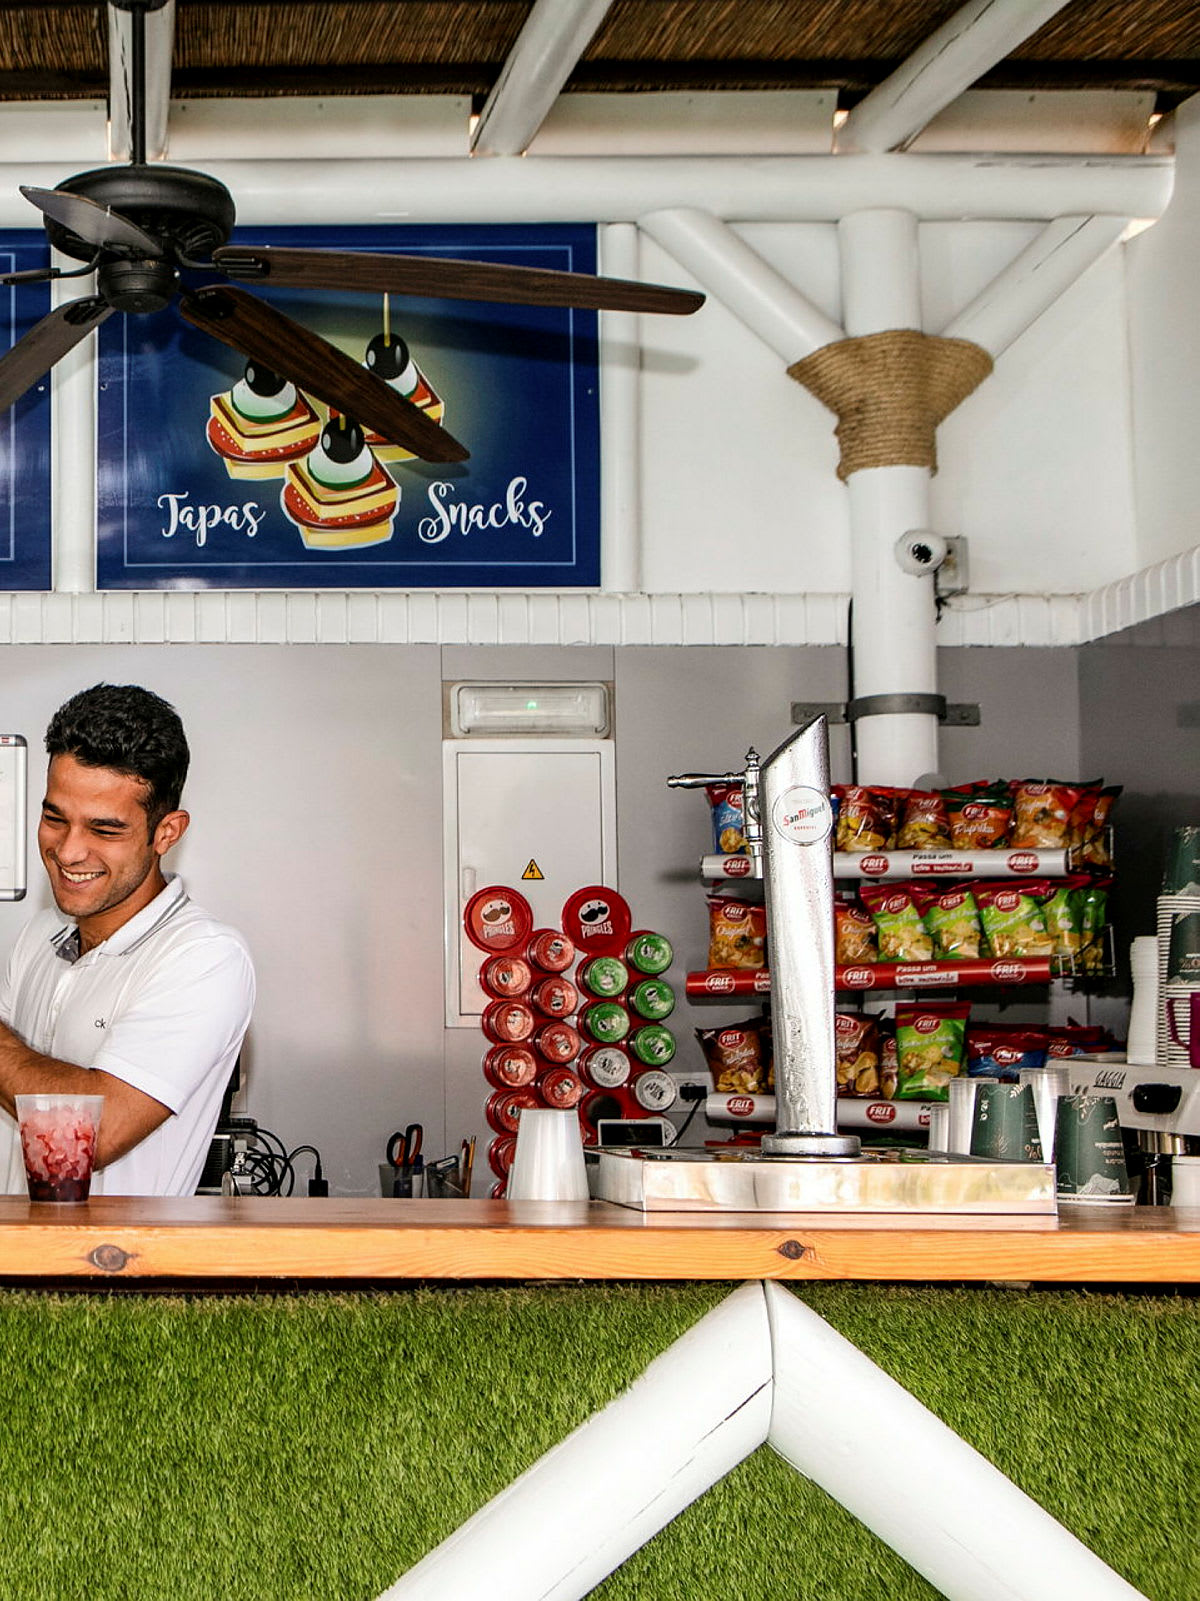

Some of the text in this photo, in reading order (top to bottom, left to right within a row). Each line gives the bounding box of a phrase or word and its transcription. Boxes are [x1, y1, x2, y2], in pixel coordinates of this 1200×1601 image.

[157, 476, 553, 547] Tapas Snacks
[862, 859, 885, 868] FRIT
[724, 905, 744, 915] FRIT
[482, 920, 515, 939] PRINGLES
[581, 921, 613, 939] PRINGLES
[847, 971, 870, 980] FRIT
[709, 978, 730, 986] FRIT
[917, 1019, 937, 1028] FRIT
[722, 1033, 741, 1042] FRIT
[729, 1100, 752, 1109] FRIT
[868, 1106, 892, 1115] FRIT
